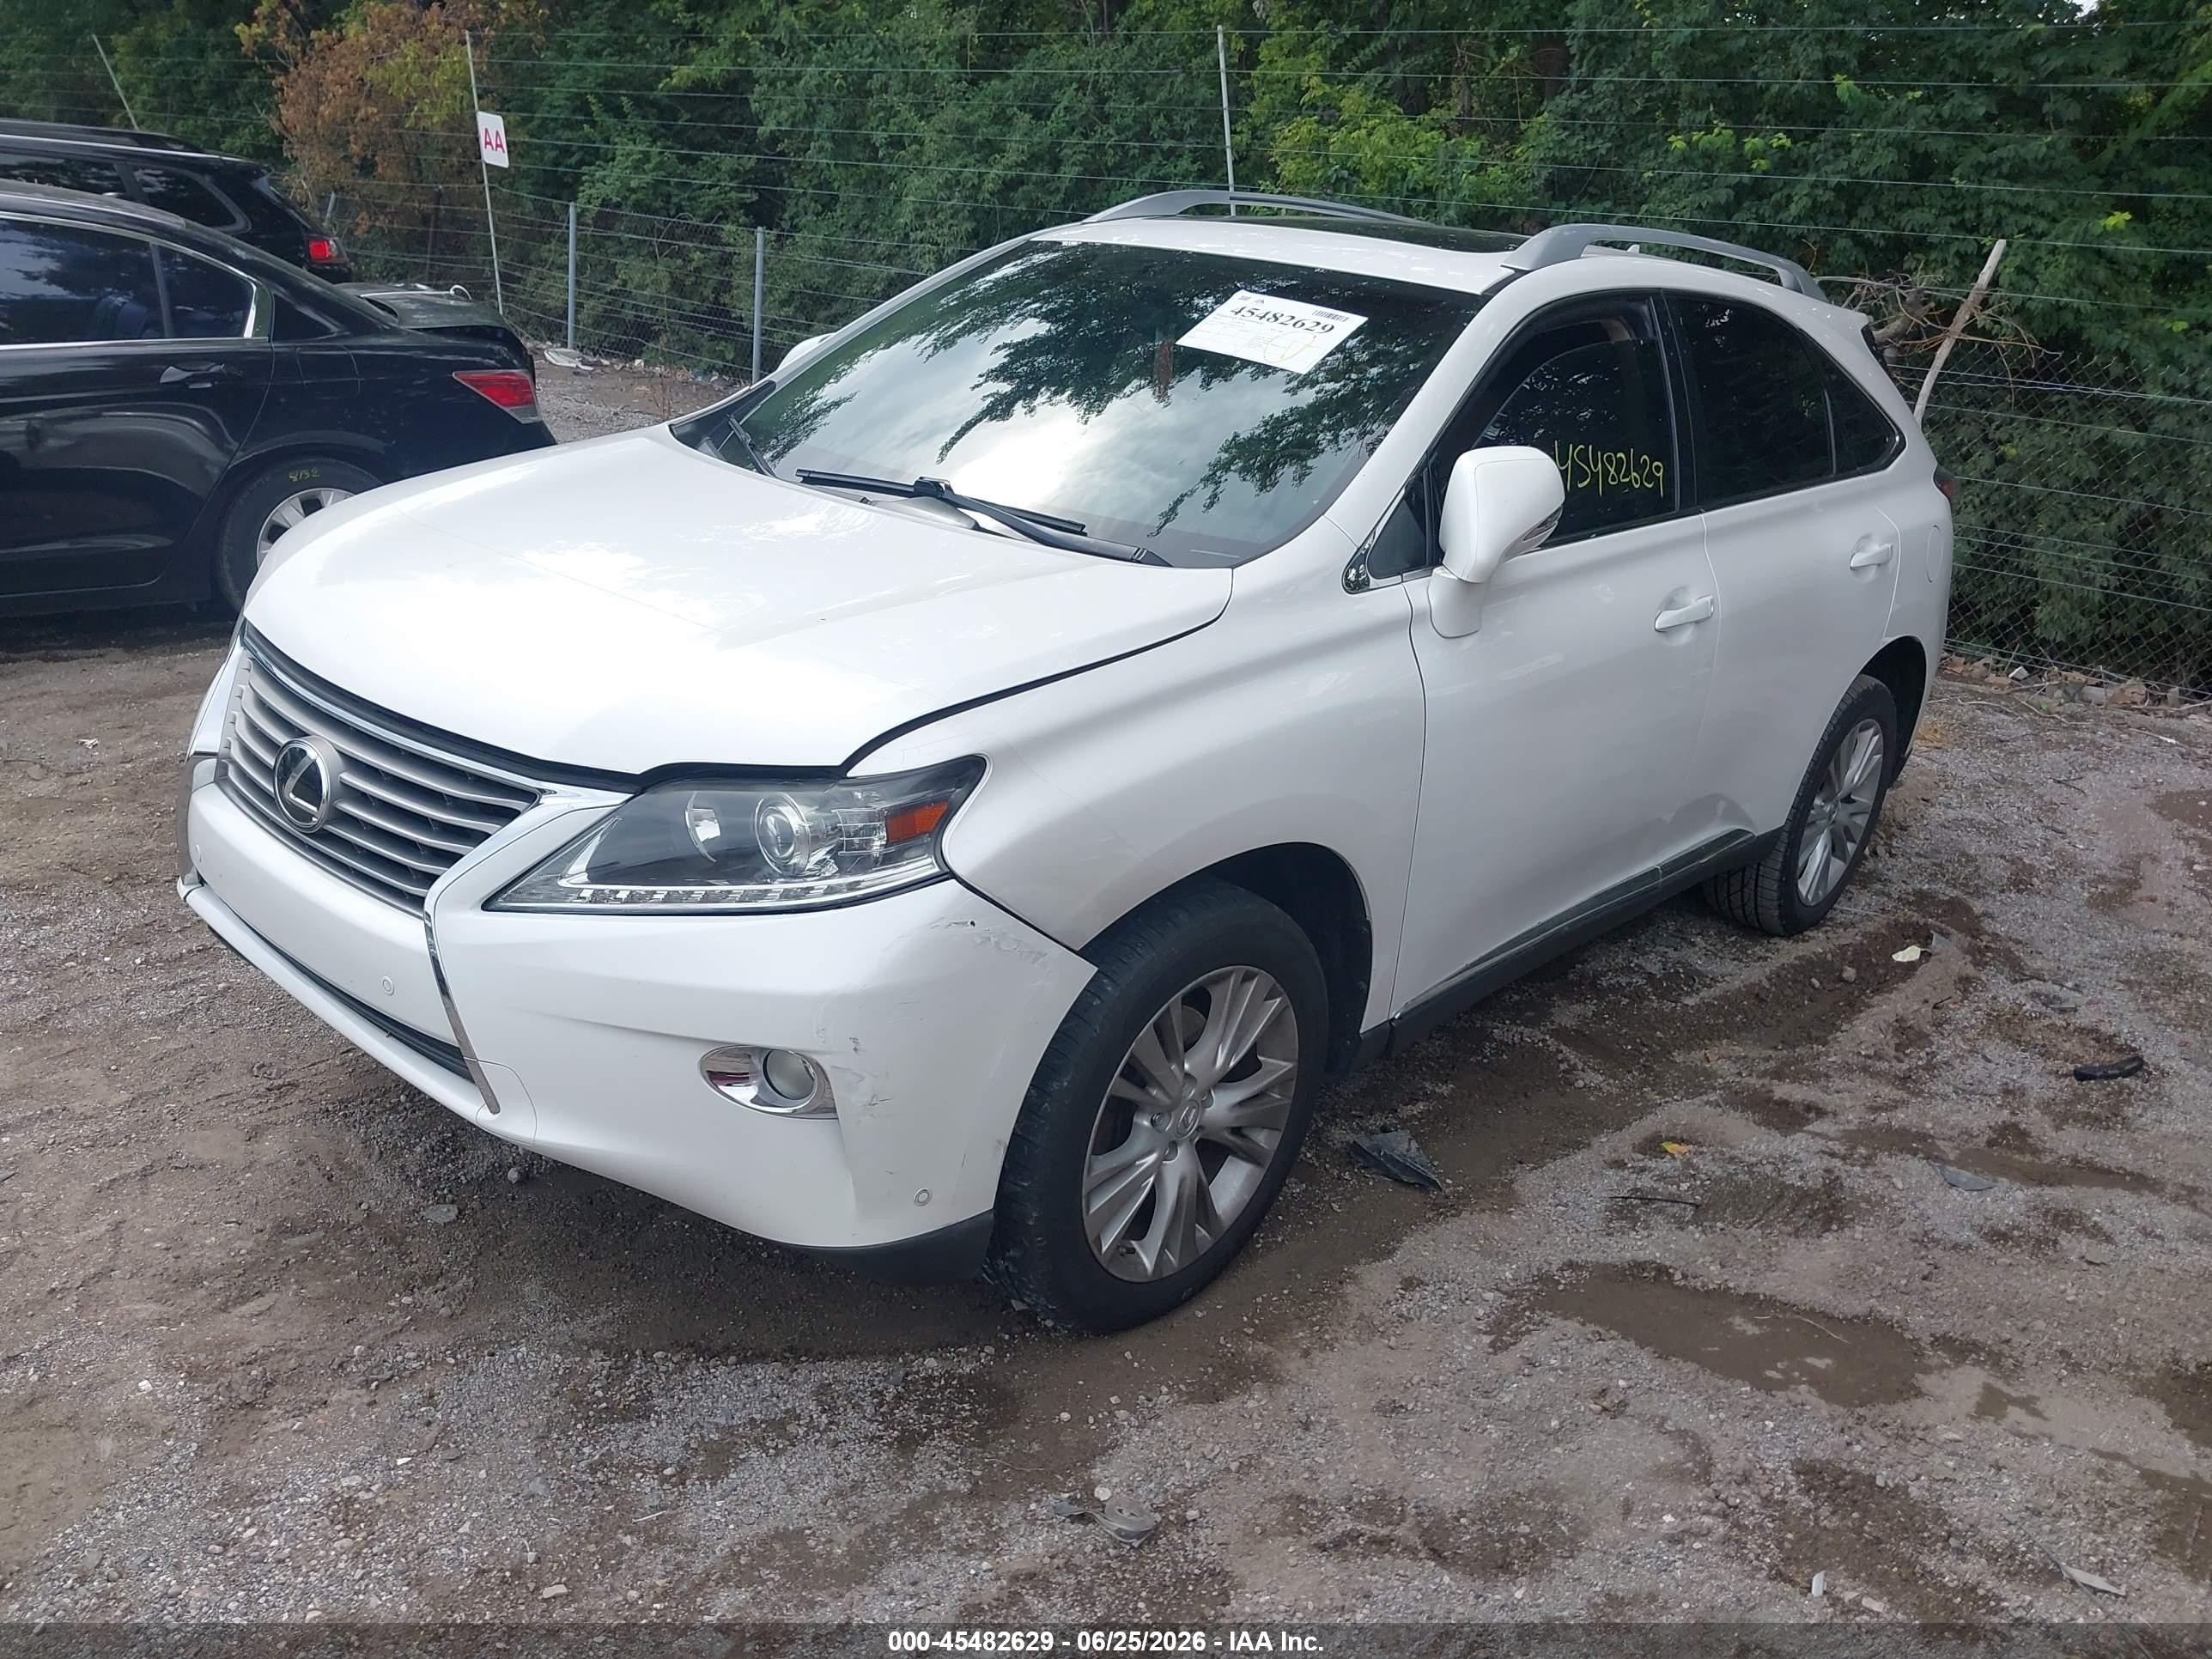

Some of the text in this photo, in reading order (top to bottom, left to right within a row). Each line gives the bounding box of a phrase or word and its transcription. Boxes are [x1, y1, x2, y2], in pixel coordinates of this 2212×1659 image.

[484, 128, 505, 154] AA
[1231, 305, 1335, 334] 45482629
[1554, 440, 1664, 498] 45482629
